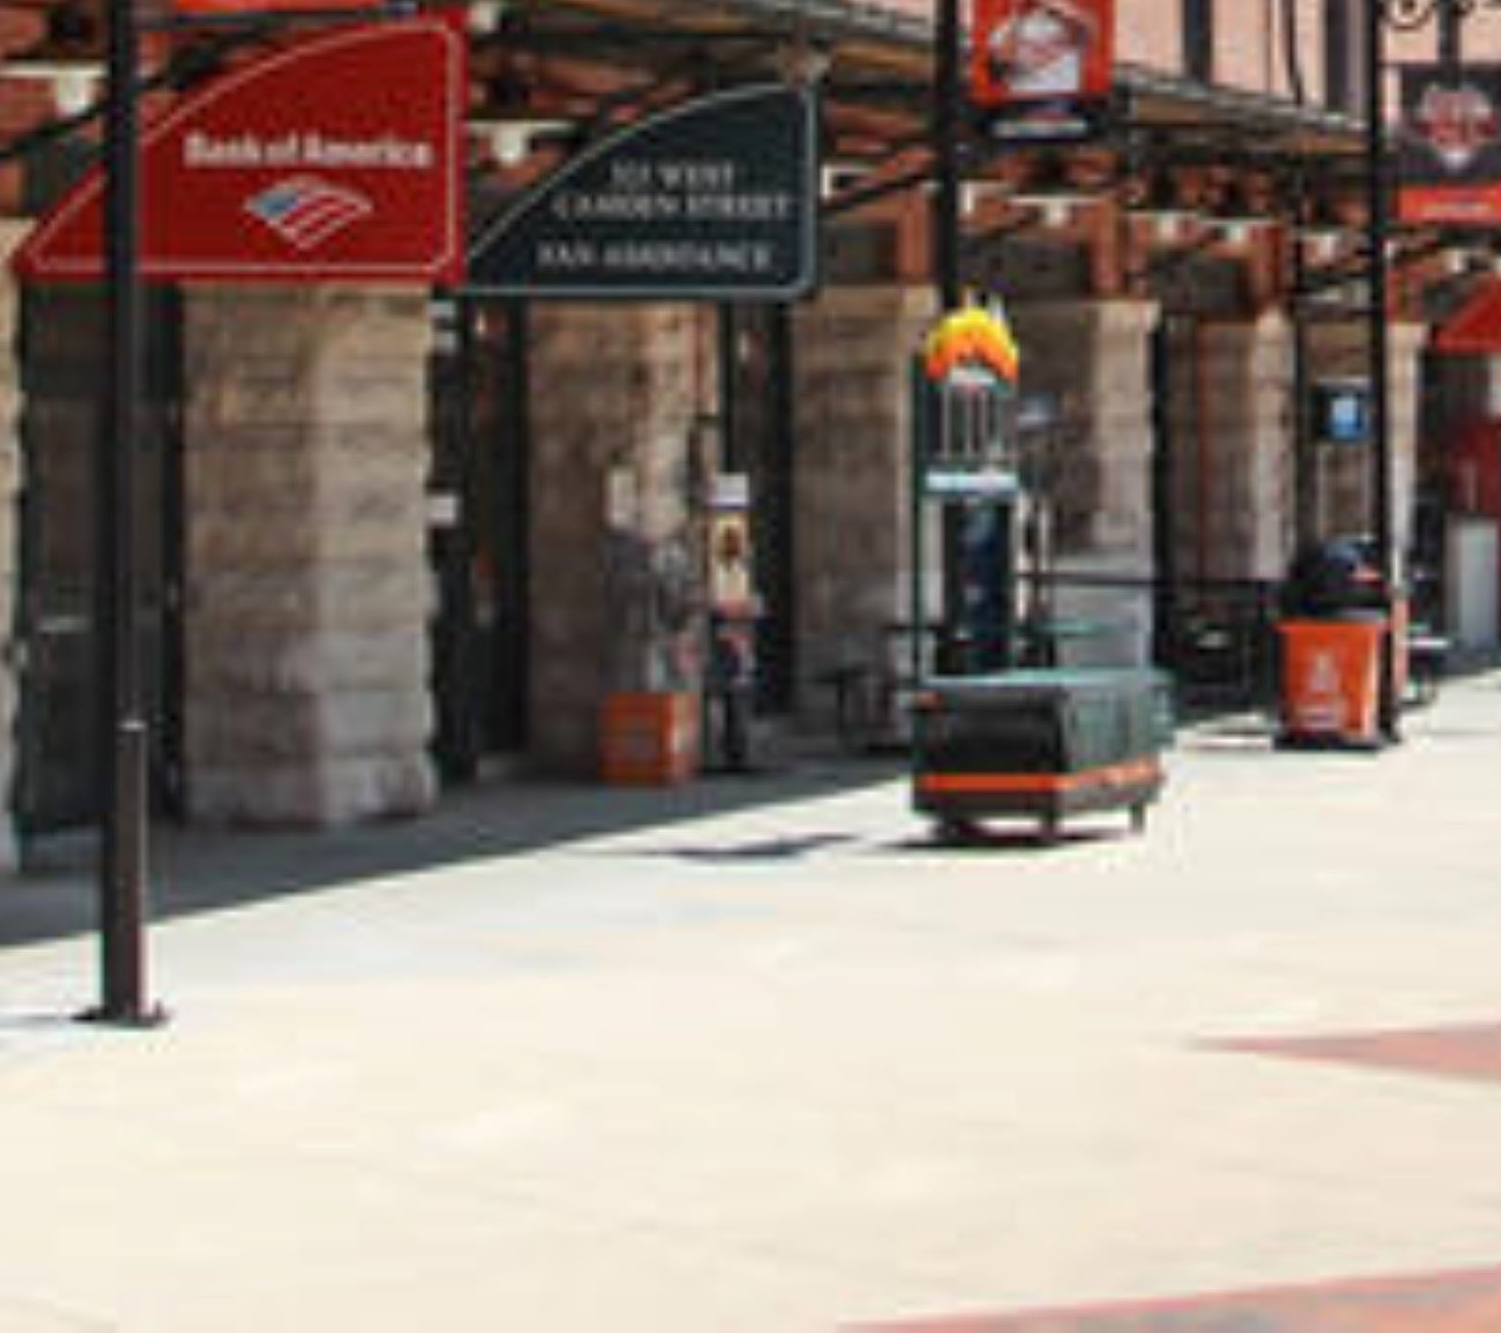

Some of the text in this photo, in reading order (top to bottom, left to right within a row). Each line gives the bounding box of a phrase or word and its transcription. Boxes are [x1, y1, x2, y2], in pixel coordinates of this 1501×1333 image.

[183, 129, 438, 169] Bank of America
